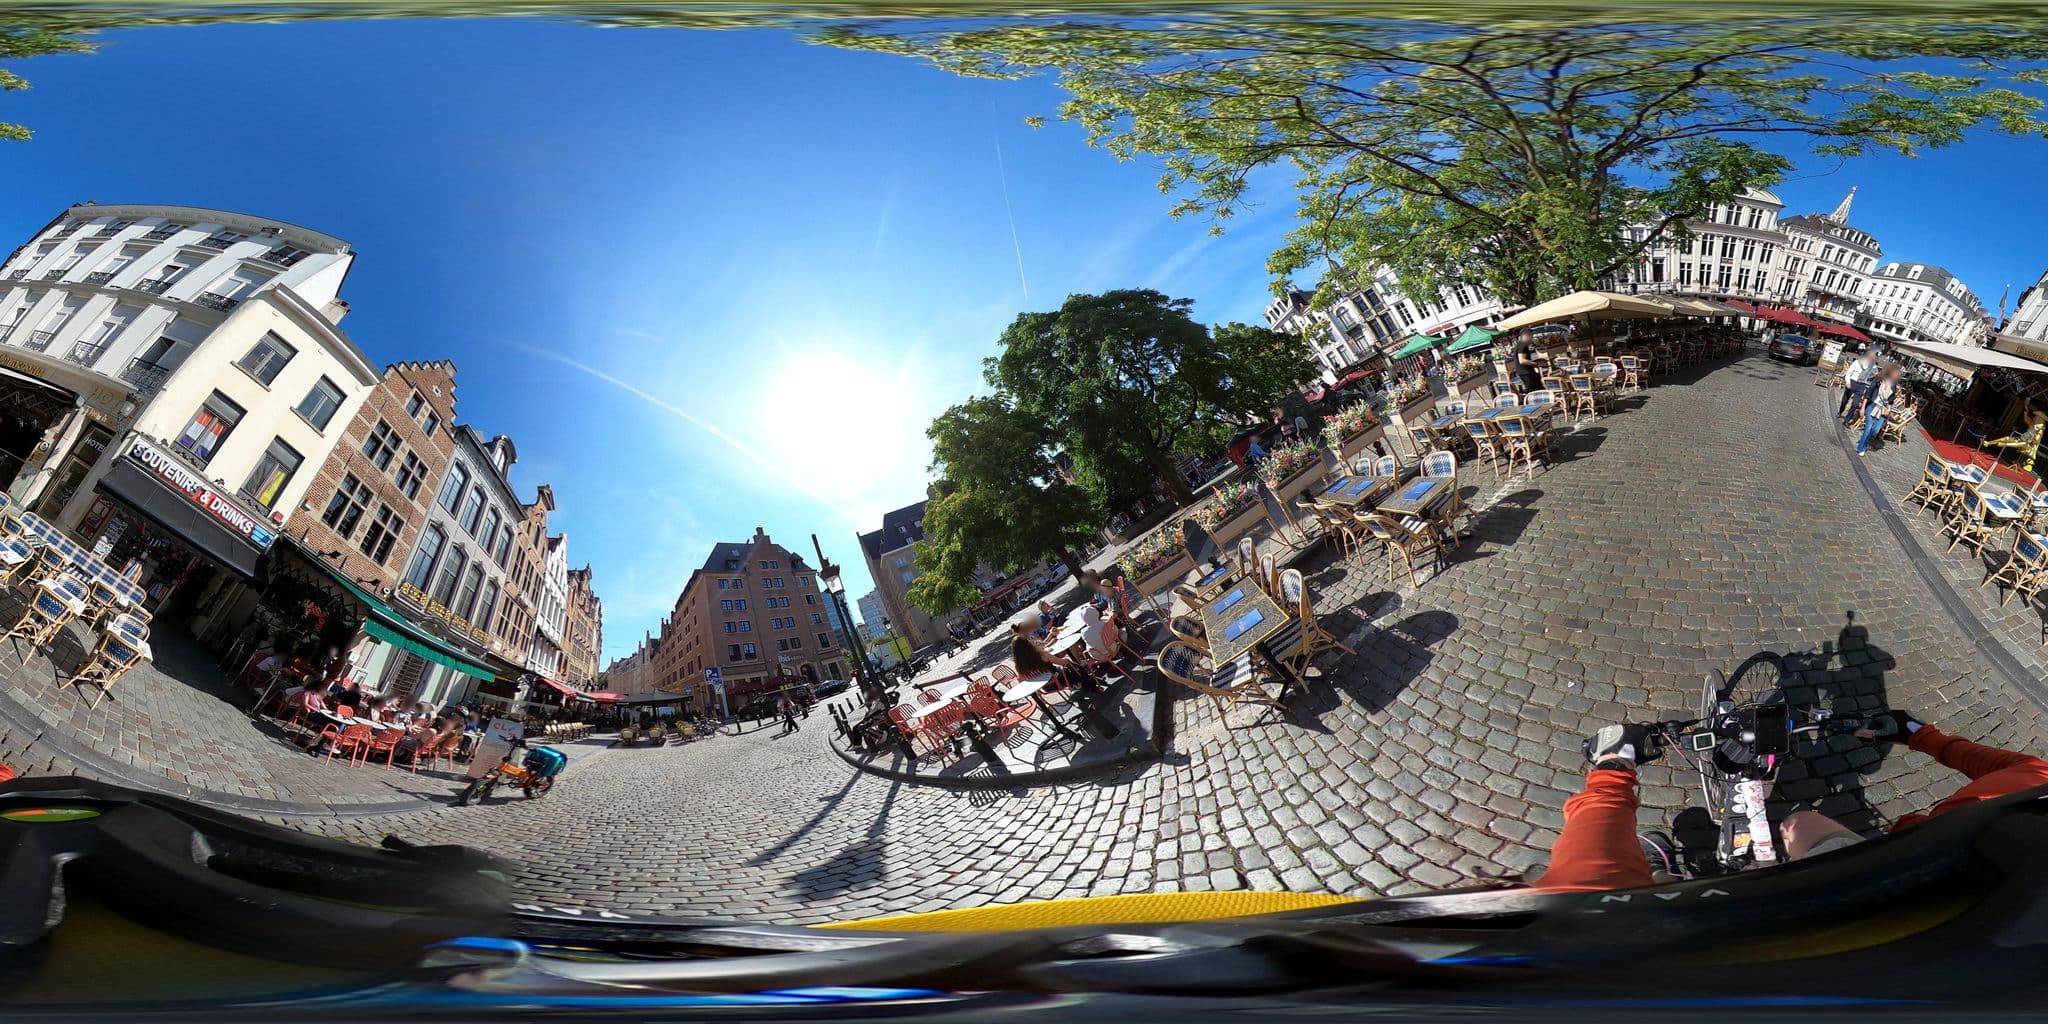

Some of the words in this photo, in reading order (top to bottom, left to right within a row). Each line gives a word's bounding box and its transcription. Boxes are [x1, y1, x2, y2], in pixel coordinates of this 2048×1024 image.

[85, 437, 106, 452] HOTE
[133, 443, 202, 496] SOUVENIRS
[199, 490, 211, 506] &
[210, 497, 254, 534] DRINKS
[705, 669, 713, 678] P
